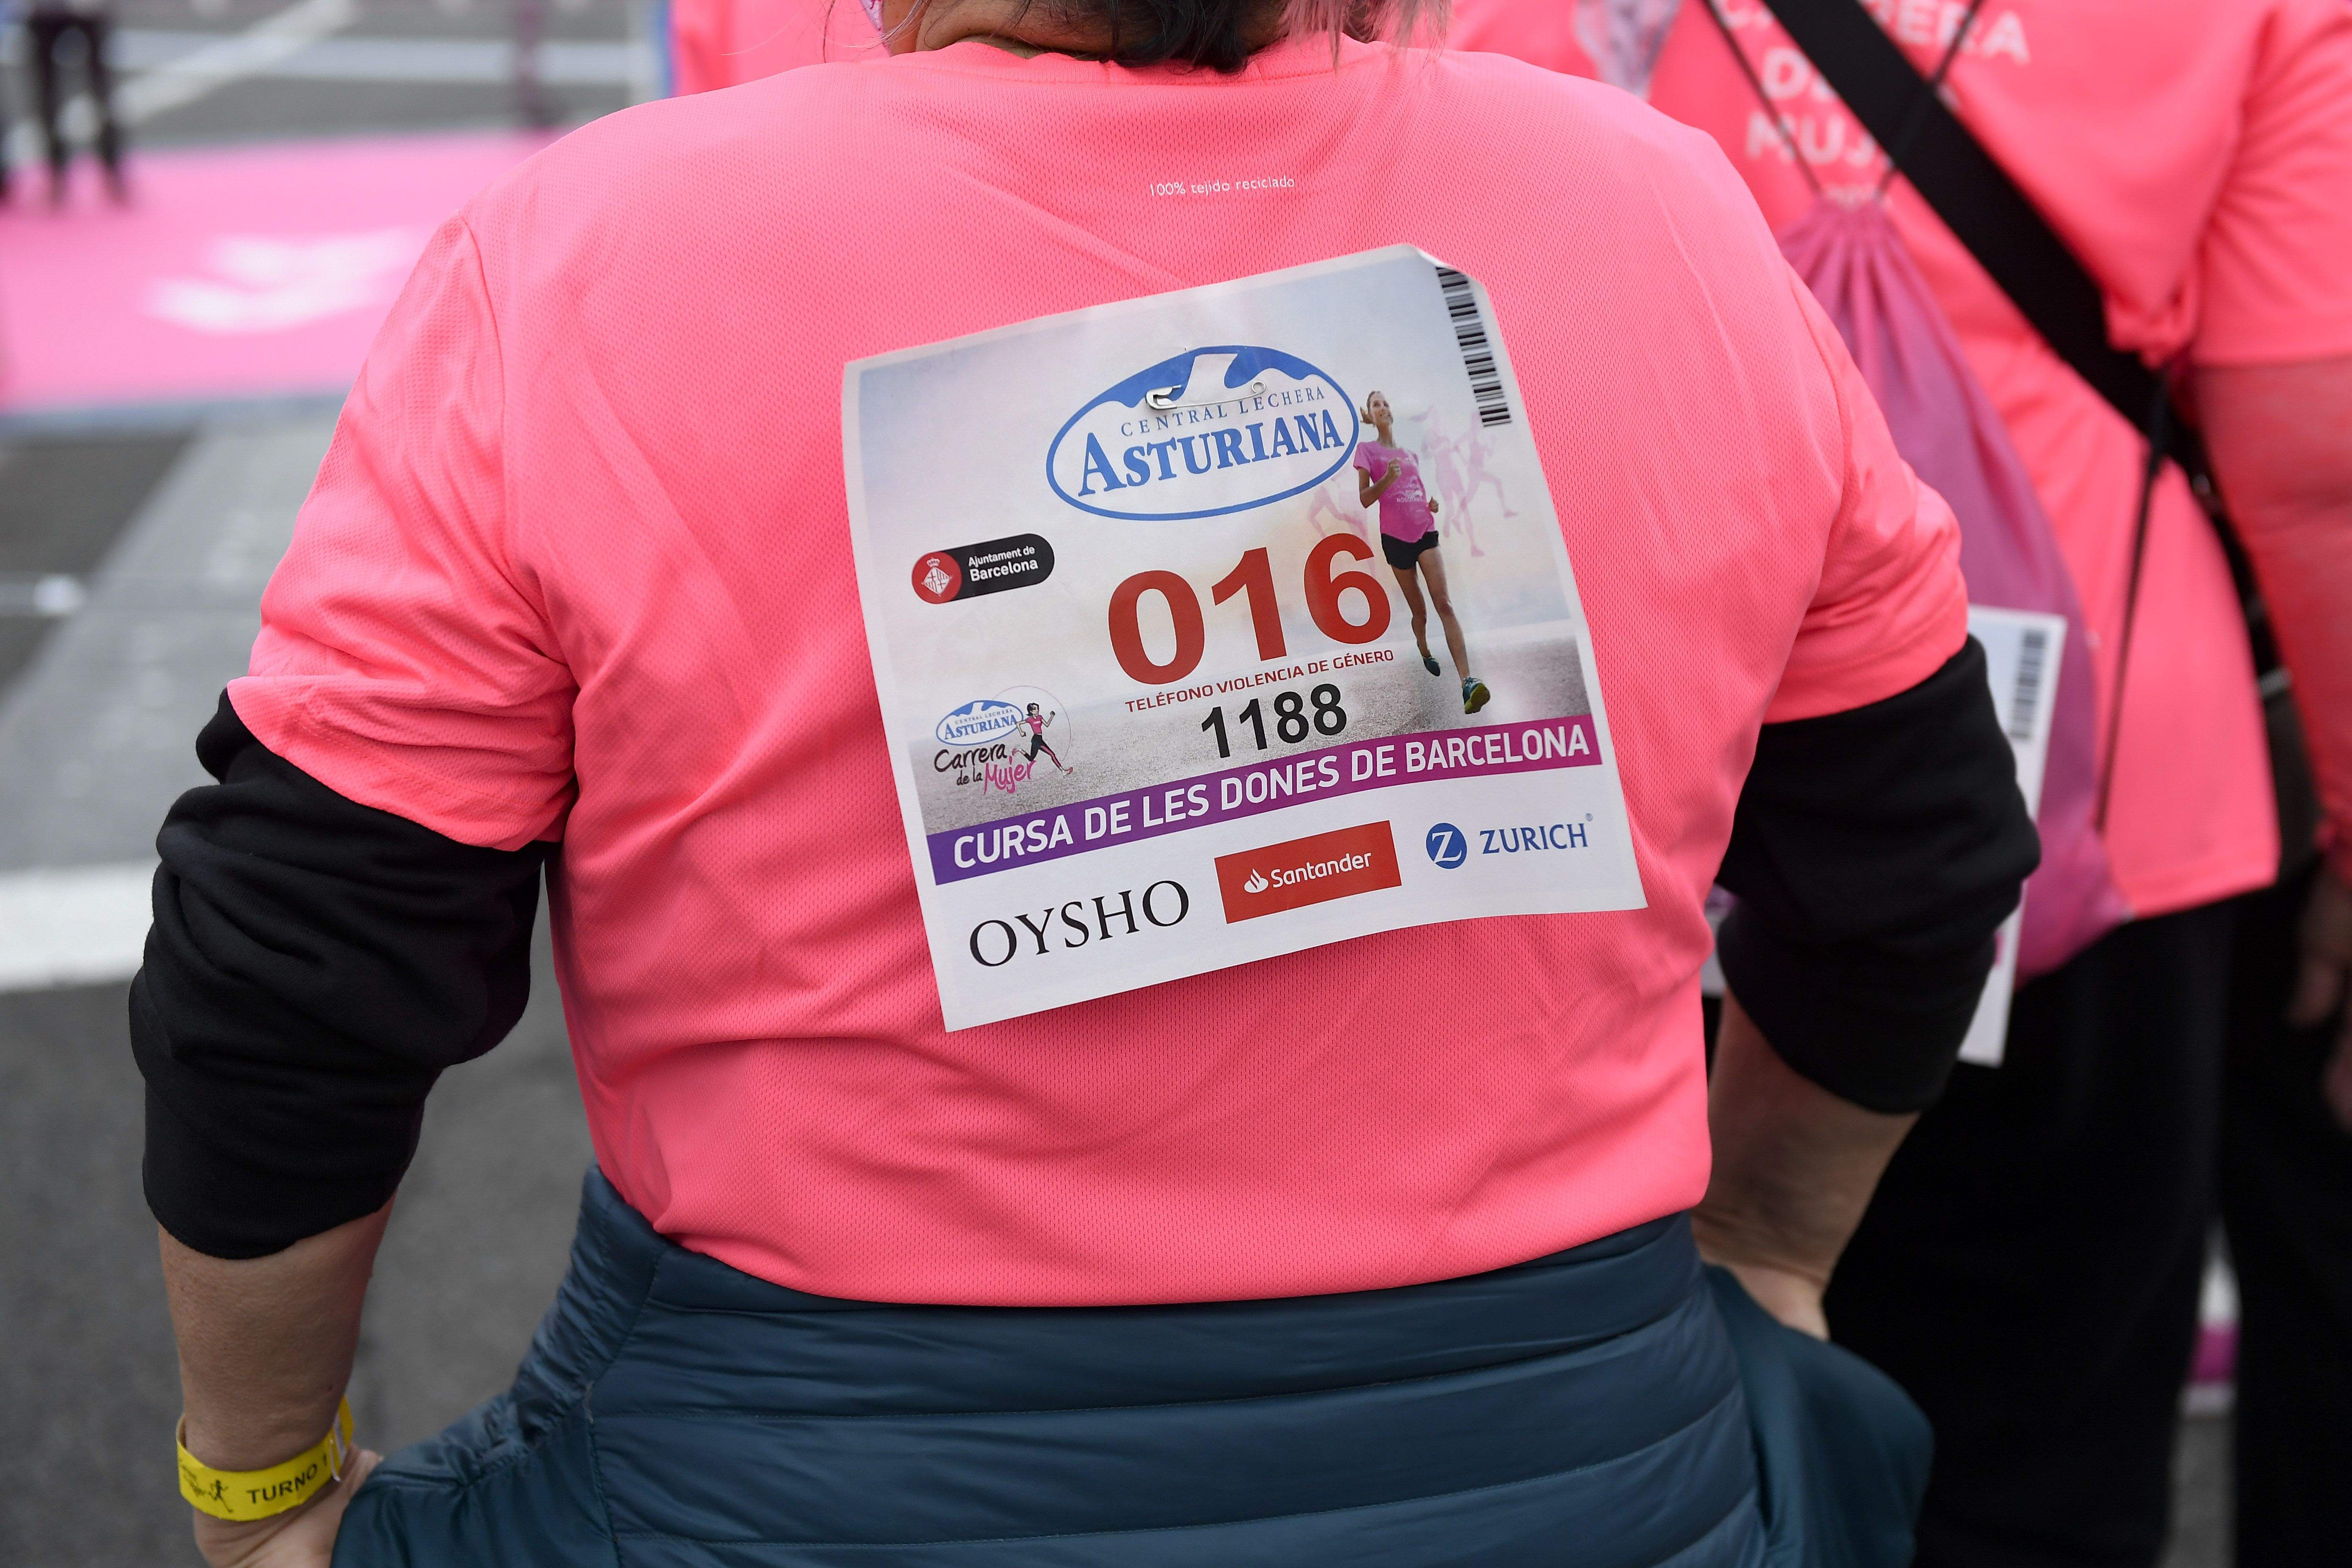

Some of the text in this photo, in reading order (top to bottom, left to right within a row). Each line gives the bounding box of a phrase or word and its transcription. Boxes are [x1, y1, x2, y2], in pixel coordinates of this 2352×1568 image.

[1712, 0, 2031, 67] CERA
[1150, 174, 1295, 196] 100% tejido reciclado
[1121, 386, 1326, 436] CENTRAL LECHERA
[1078, 408, 1345, 497] ASTURIANA
[968, 545, 1036, 568] Ajuntament de
[969, 558, 1039, 582] Barcelona
[1108, 533, 1391, 685] 016
[1125, 649, 1394, 713] TELÉFONO VIOLENCIA DE GÉNERO
[945, 714, 1017, 740] ASTURIANA
[955, 708, 1013, 725] CENTRAL LECHERA
[1201, 683, 1348, 759] 1188
[934, 743, 1007, 773] Carrera
[956, 755, 1037, 796] de la Mujer
[953, 724, 1591, 869] CURSA DE LES DONES DE BARCELONA
[1479, 822, 1589, 855] ZURICH
[1270, 851, 1372, 889] Santander
[969, 880, 1190, 968] OYSHO
[246, 1463, 318, 1504] TURNO
